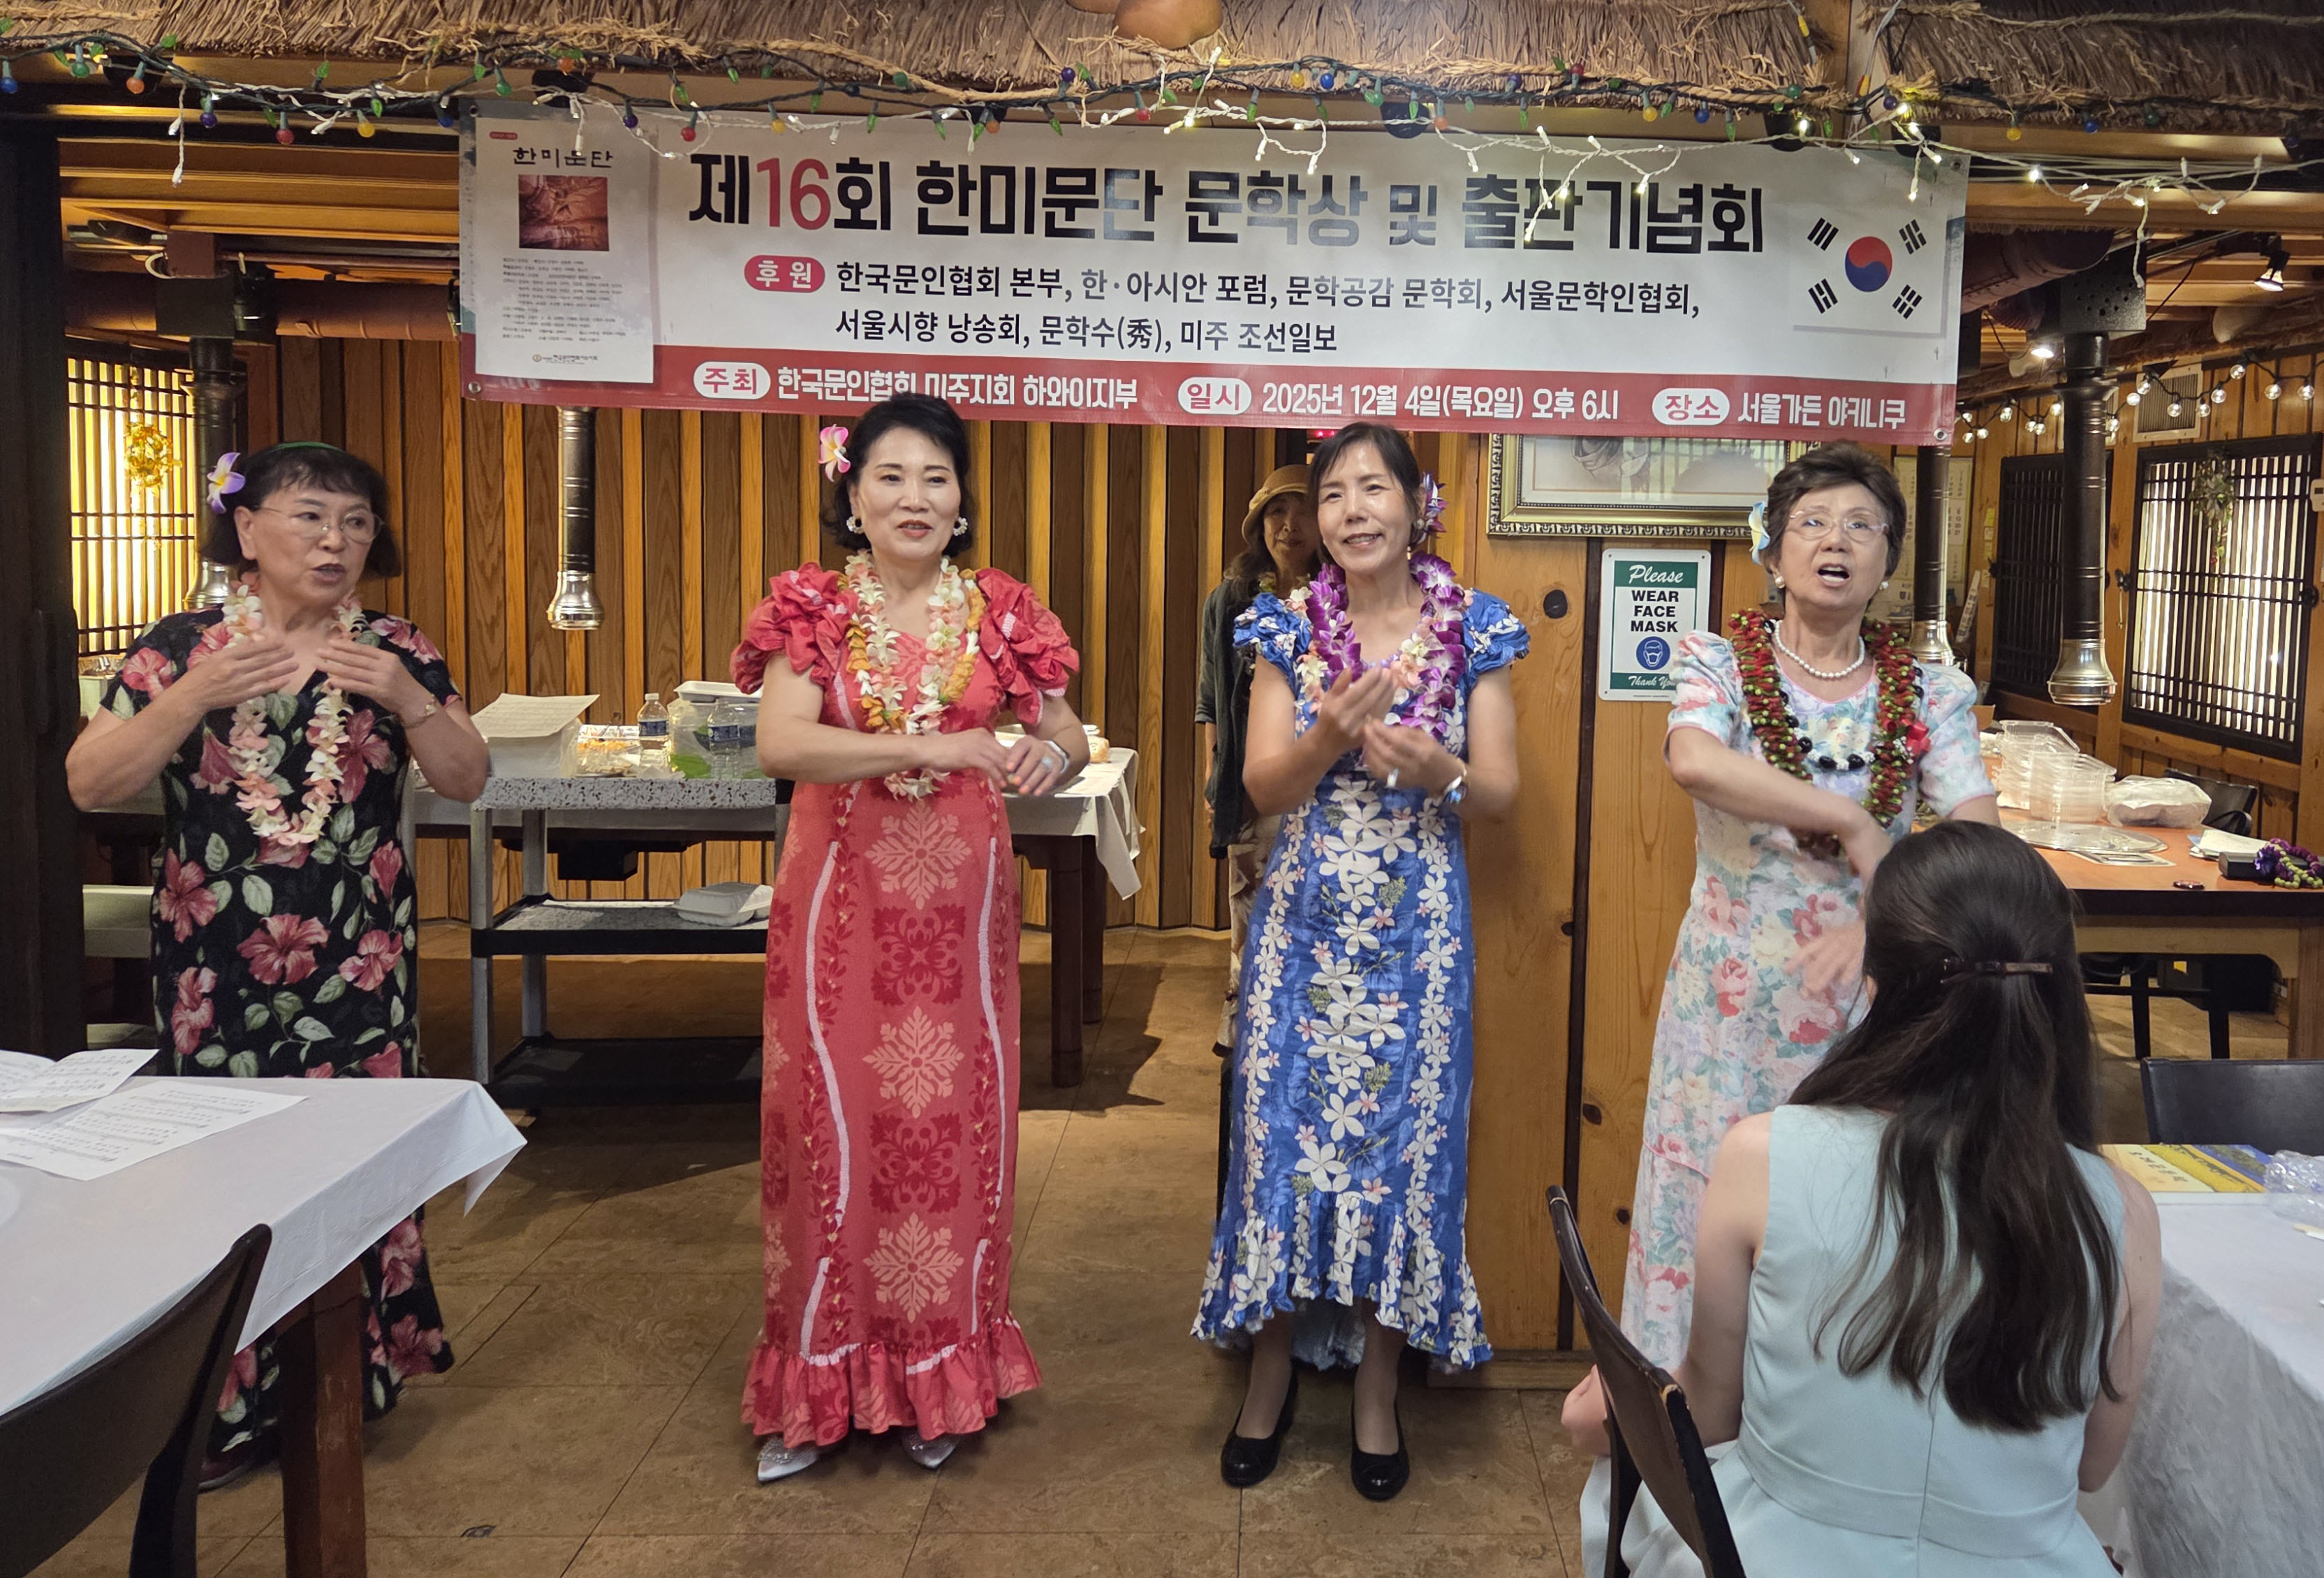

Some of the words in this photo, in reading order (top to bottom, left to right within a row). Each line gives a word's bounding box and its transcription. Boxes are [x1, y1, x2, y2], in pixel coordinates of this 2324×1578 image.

[513, 147, 613, 168] 한미문단
[689, 154, 890, 230] 제16회
[916, 160, 1163, 241] 한미문단
[1186, 170, 1367, 246] 문학상
[1390, 184, 1437, 246] 및
[1462, 174, 1763, 253] 출판기념회
[837, 262, 999, 297] 한국문인협회
[1010, 267, 1072, 302] 본부,
[1216, 274, 1277, 308] 포럼,
[1286, 275, 1394, 308] 문학공감
[1402, 278, 1492, 313] 문학회,
[1501, 280, 1699, 318] 서울문학인협회,
[836, 309, 938, 342] 서울시향
[948, 313, 1029, 348] 낭송회,
[1182, 320, 1228, 351] 미주
[1238, 323, 1337, 353] 조선일보
[703, 367, 757, 395] 주최
[778, 367, 915, 401] 한국문인협회
[925, 373, 1014, 405] 미주지회
[1023, 374, 1137, 409] 하와이지부
[1186, 383, 1241, 411] 일시
[1263, 383, 1343, 415] 2025년
[1350, 385, 1397, 416] 12월
[1404, 385, 1523, 419] 4일(목요일)
[1531, 388, 1575, 419] 오후
[1582, 390, 1619, 420] 6시
[1664, 394, 1721, 420] 장소
[1737, 392, 1822, 426] 서울가든
[1828, 397, 1905, 429] 야키니쿠
[1629, 564, 1684, 585] Please
[1631, 590, 1679, 603] WEAR
[1634, 605, 1675, 617] FACE
[1631, 620, 1678, 633] MASK
[1628, 675, 1657, 686] Thank
